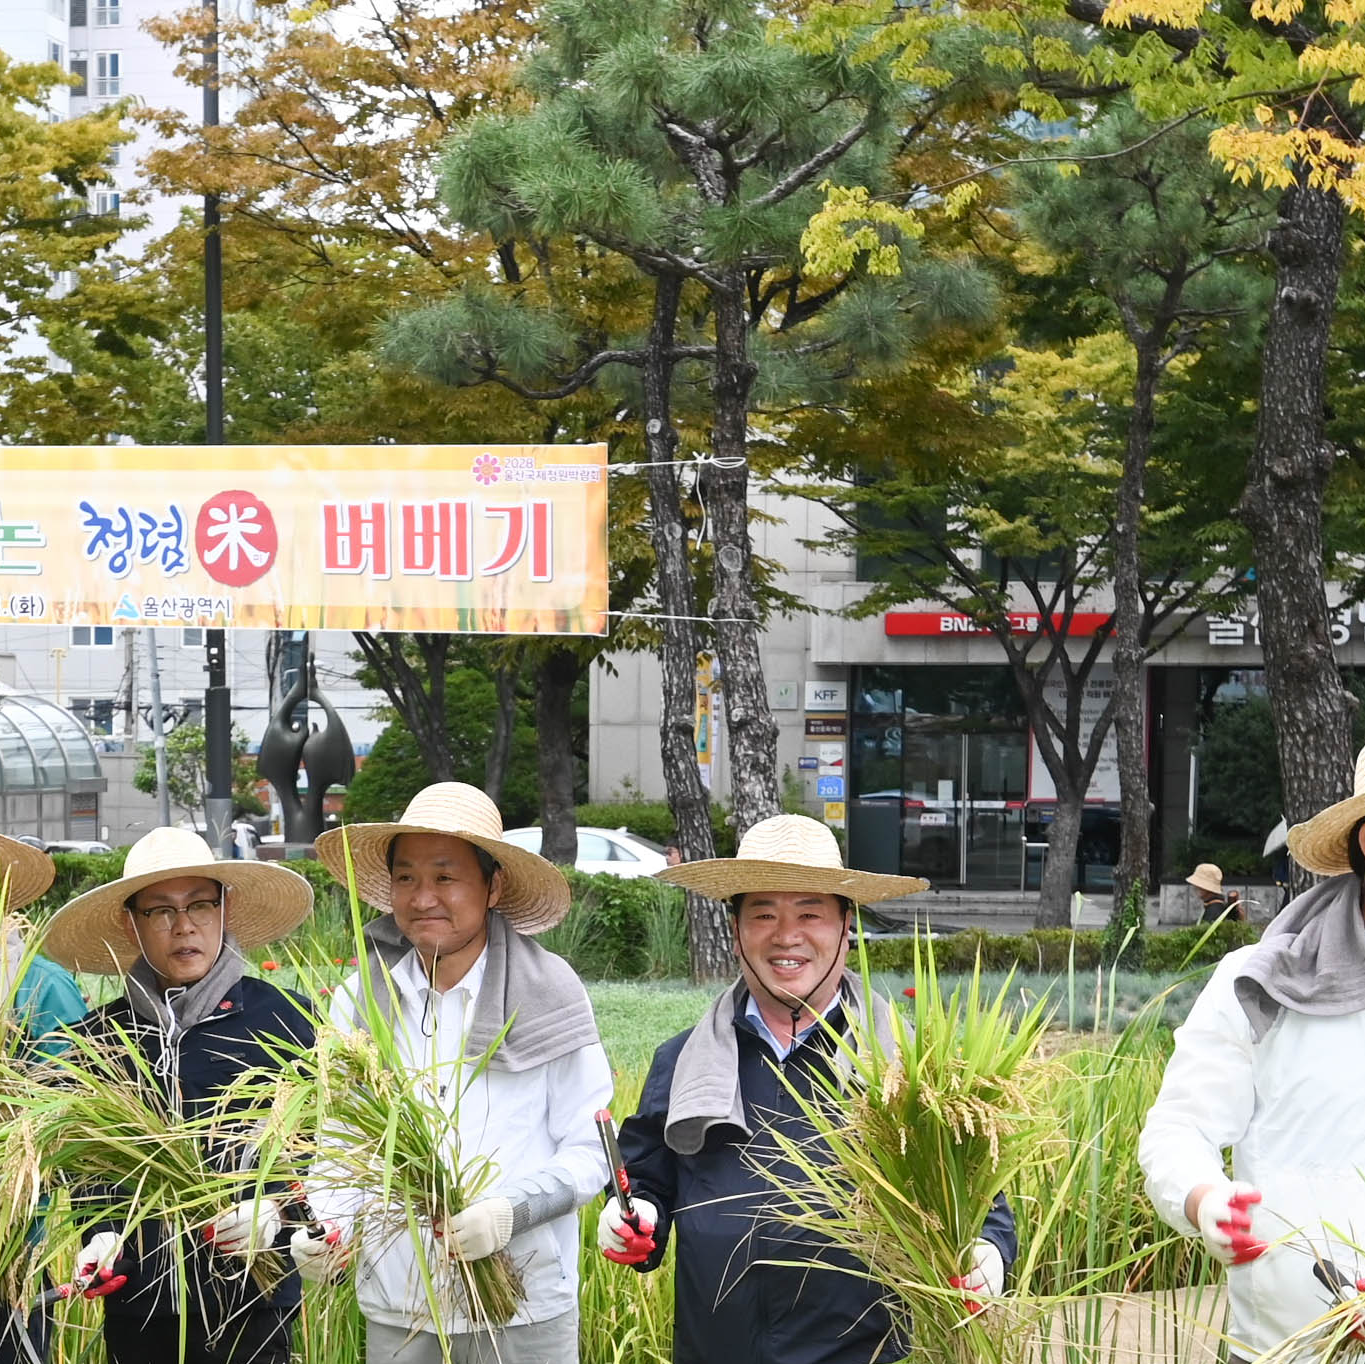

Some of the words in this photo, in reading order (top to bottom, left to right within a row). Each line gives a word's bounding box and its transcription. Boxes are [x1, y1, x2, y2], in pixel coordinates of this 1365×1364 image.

[504, 458, 534, 469] 2028
[78, 501, 185, 572] 청렴
[203, 501, 270, 571] 米
[323, 501, 548, 577] 벼베기
[143, 596, 231, 619] 울산광역시
[813, 688, 839, 701] KFF
[820, 785, 839, 795] 202
